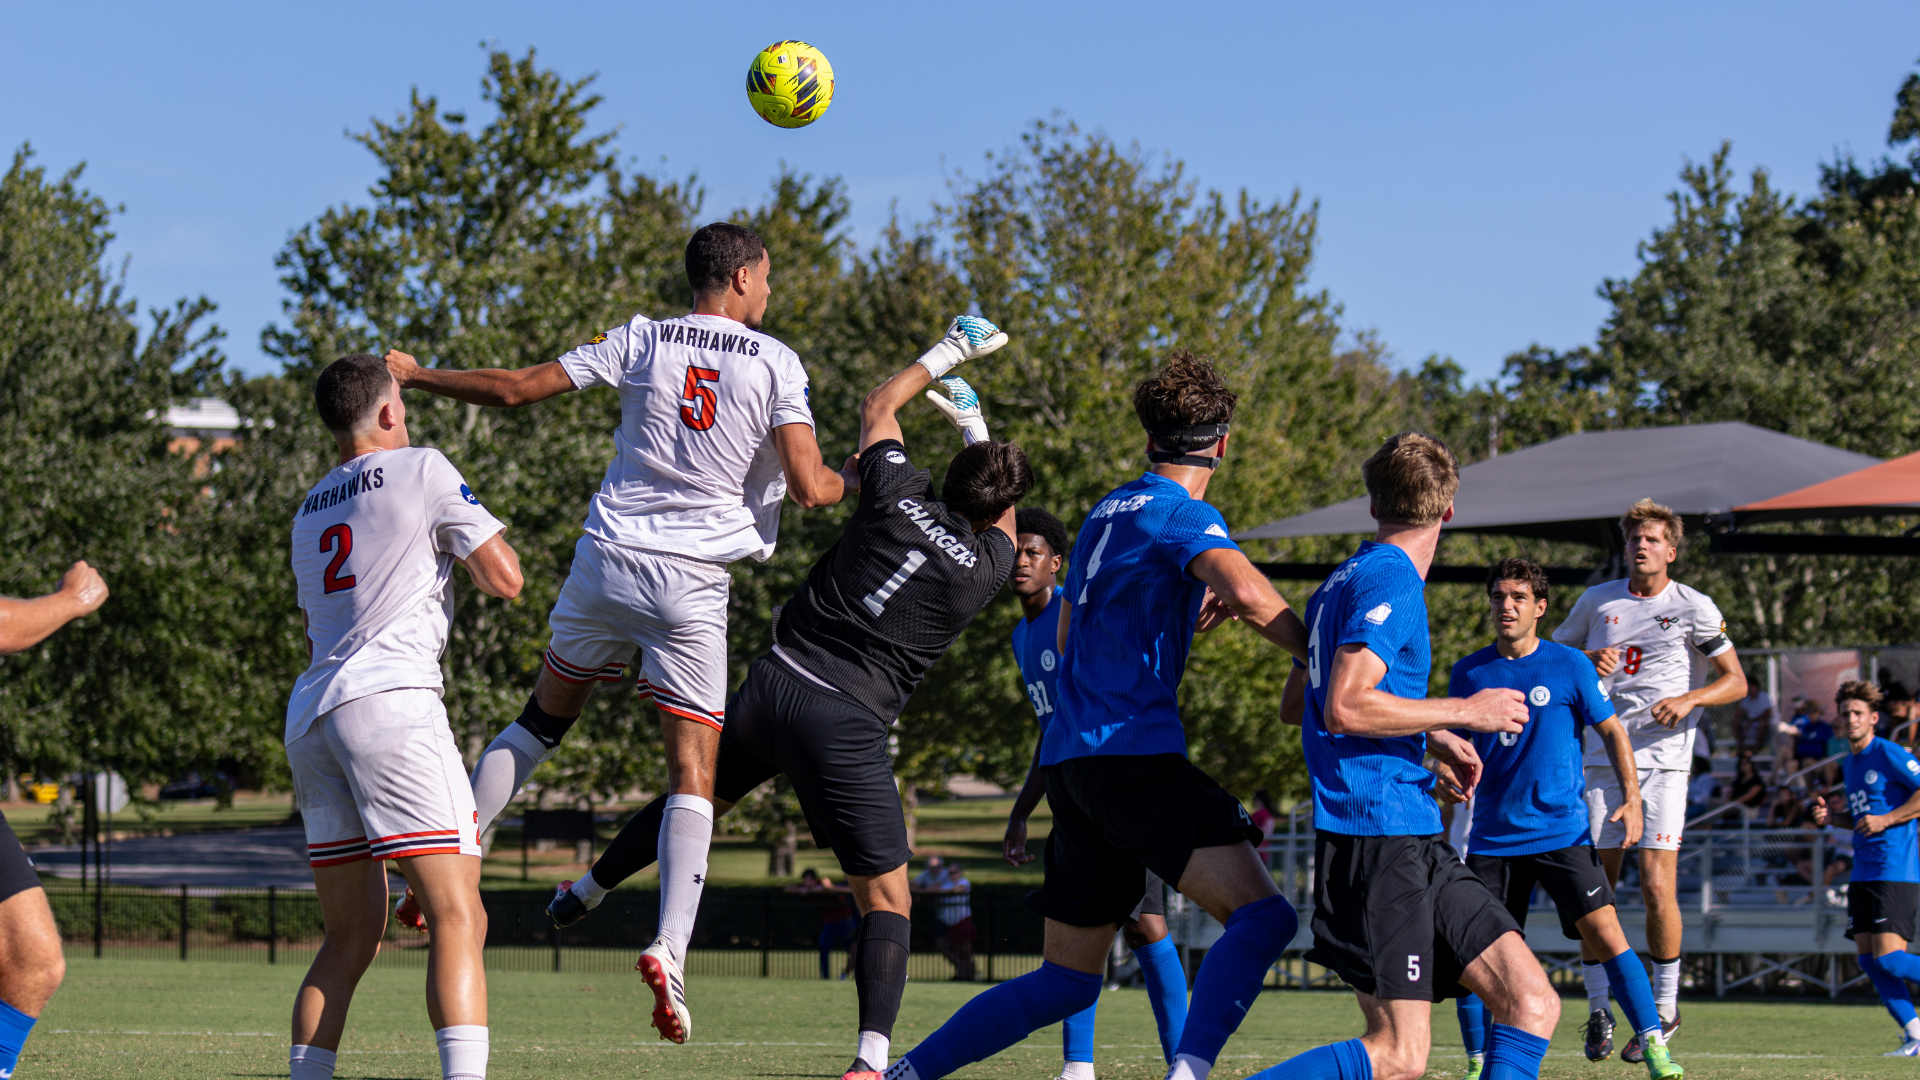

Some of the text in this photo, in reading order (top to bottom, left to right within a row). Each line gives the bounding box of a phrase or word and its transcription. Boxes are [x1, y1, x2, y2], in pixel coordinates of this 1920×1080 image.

[660, 324, 760, 356] WARHAWKS
[680, 366, 720, 431] 5
[302, 467, 384, 517] WARHAWKS
[898, 498, 977, 568] CHARGERS
[320, 523, 356, 594] 2
[862, 550, 927, 616] 1
[1624, 646, 1643, 675] 9
[1028, 680, 1053, 717] 31
[1237, 803, 1252, 825] 4
[1849, 789, 1871, 816] 22
[1407, 955, 1420, 981] 5
